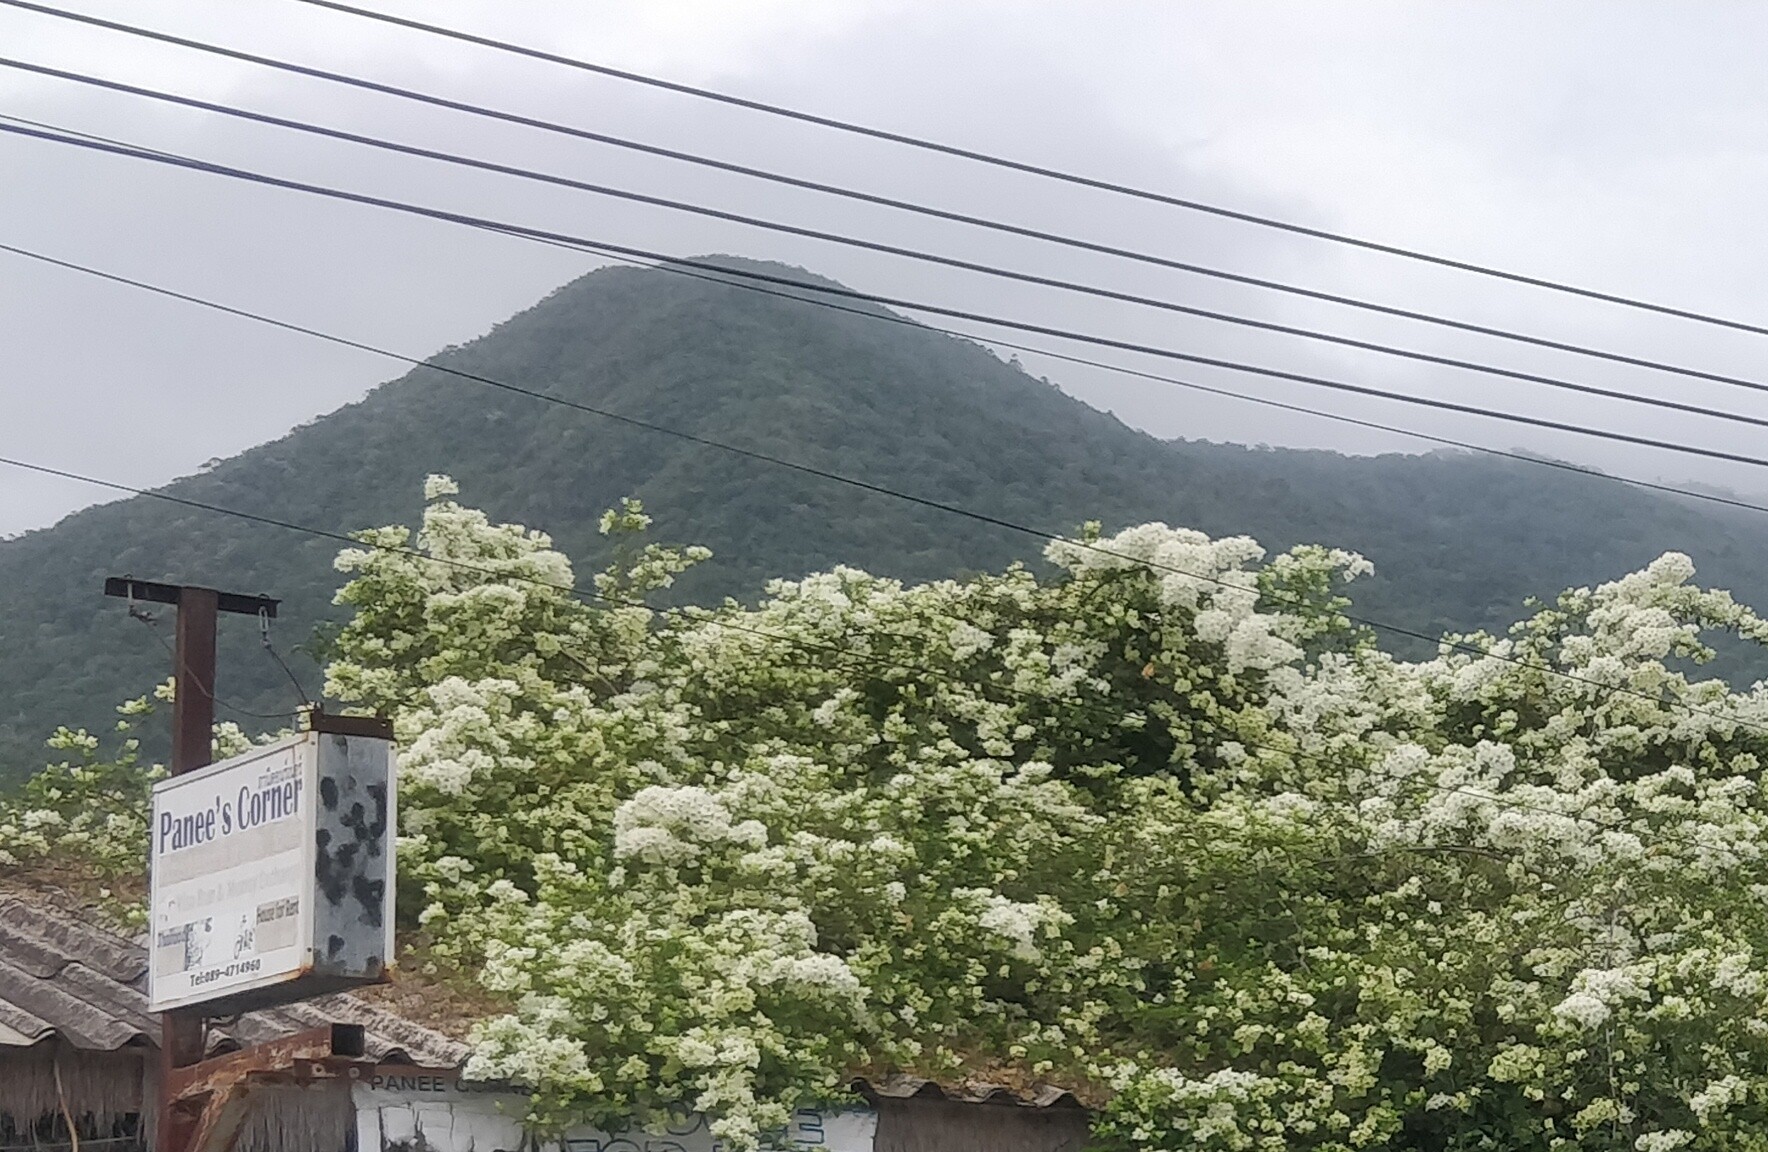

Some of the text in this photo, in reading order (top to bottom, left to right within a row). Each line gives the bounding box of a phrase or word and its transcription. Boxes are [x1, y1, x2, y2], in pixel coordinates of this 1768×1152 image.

[159, 778, 303, 854] Panee's Corner
[370, 1075, 445, 1093] PANEE
